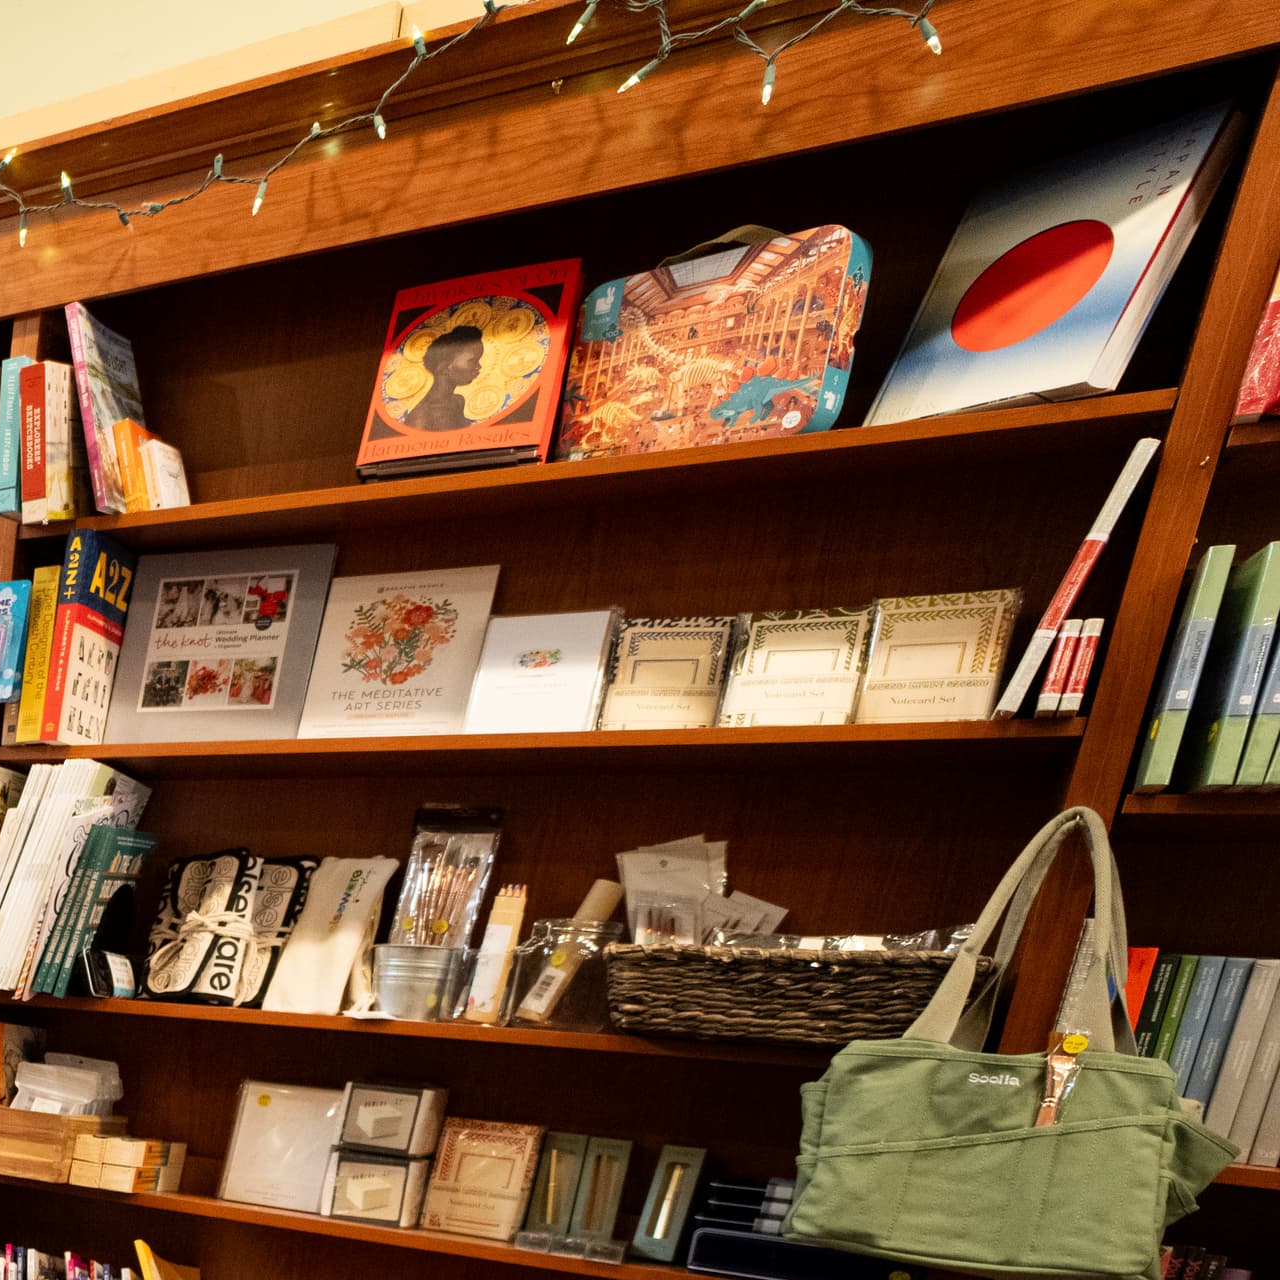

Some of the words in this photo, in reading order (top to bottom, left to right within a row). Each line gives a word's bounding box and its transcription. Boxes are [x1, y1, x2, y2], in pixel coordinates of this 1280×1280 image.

[362, 431, 450, 459] Harmonia
[457, 428, 530, 447] Rosales
[90, 551, 132, 613] A2Z
[154, 634, 178, 649] the
[182, 636, 212, 648] knot
[215, 635, 247, 644] Wedding
[249, 633, 280, 642] Planner
[331, 691, 356, 700] THE
[361, 688, 443, 698] MEDITATIVE
[889, 696, 935, 705] Notecard
[940, 695, 956, 704] Set
[344, 702, 369, 711] ART
[375, 700, 422, 711] SERIES
